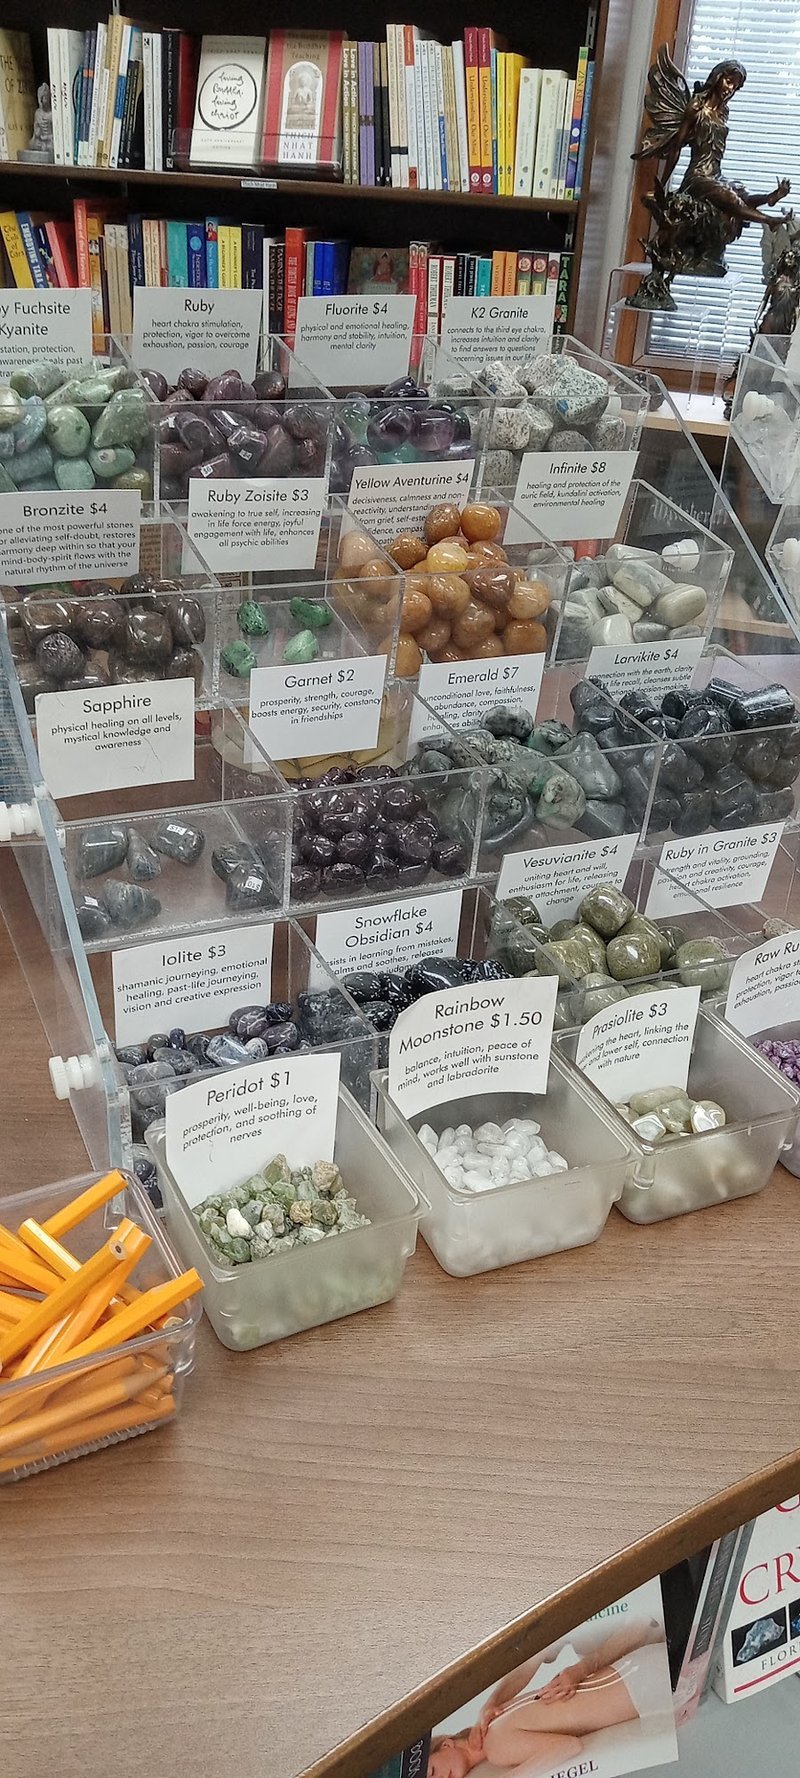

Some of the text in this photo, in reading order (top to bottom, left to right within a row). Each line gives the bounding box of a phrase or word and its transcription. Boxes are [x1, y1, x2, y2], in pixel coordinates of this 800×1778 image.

[557, 257, 570, 303] TARA
[15, 302, 71, 314] Fuchsite
[185, 299, 215, 315] Ruby
[325, 302, 388, 315] Fluorite $4
[471, 307, 528, 318] K2 Granite
[152, 319, 243, 329] heart chakra stimulation,
[301, 324, 328, 332] physical
[330, 322, 343, 330] and
[382, 322, 409, 330] healing,
[33, 345, 75, 354] protection,
[550, 462, 606, 474] Infinite $8
[355, 473, 469, 489] Yellow Aventurine $4
[208, 489, 309, 504] Ruby Zoisite $3
[23, 502, 107, 517] Bronzite $4
[191, 510, 235, 519] awakening
[265, 508, 280, 517] self,
[67, 522, 104, 533] powerful
[254, 520, 280, 528] energy,
[614, 649, 679, 664] Larvikite $4
[285, 669, 354, 688] Garnet $2
[448, 666, 519, 684] Emerald $7
[260, 688, 374, 708] prosperity, strength, courage,
[494, 685, 536, 695] faithfulness,
[83, 695, 152, 714] Sapphire
[252, 698, 382, 718] boosts energy, security, constancy
[51, 721, 88, 735] physical
[91, 718, 125, 730] healing
[142, 714, 152, 724] all
[156, 712, 182, 722] levels,
[301, 712, 343, 723] friendships
[64, 724, 171, 744] mystical knowledge and
[95, 739, 142, 751] awareness
[665, 832, 777, 860] Ruby in Granite $3
[523, 844, 618, 868] Vesuvianite $4
[355, 906, 427, 929] Snowflake
[345, 921, 433, 948] Obsidian $4
[162, 945, 226, 967] Iolite $3
[360, 936, 454, 961] learning from mistakes,
[754, 949, 780, 966] Raw
[117, 957, 268, 993] shamanic journeying, emotional
[126, 971, 259, 1002] healing, past-life journeying,
[123, 981, 261, 1014] vision and creative expression
[435, 996, 505, 1020] Rainbow
[592, 1002, 668, 1039] Prasiolite $3
[399, 1011, 542, 1055] Moonstone $1.50
[606, 1022, 689, 1047] the heart, linking the
[624, 1034, 689, 1052] self, connection
[405, 1039, 532, 1075] balance, intuition, peace of
[397, 1053, 539, 1091] mind, works well with sunstone
[427, 1065, 499, 1089] and labradorite
[207, 1071, 291, 1106] Peridot $1
[182, 1094, 318, 1138] prosperity, well-being, love,
[182, 1105, 317, 1151] protection, and soothing of
[230, 1127, 262, 1143] nerves
